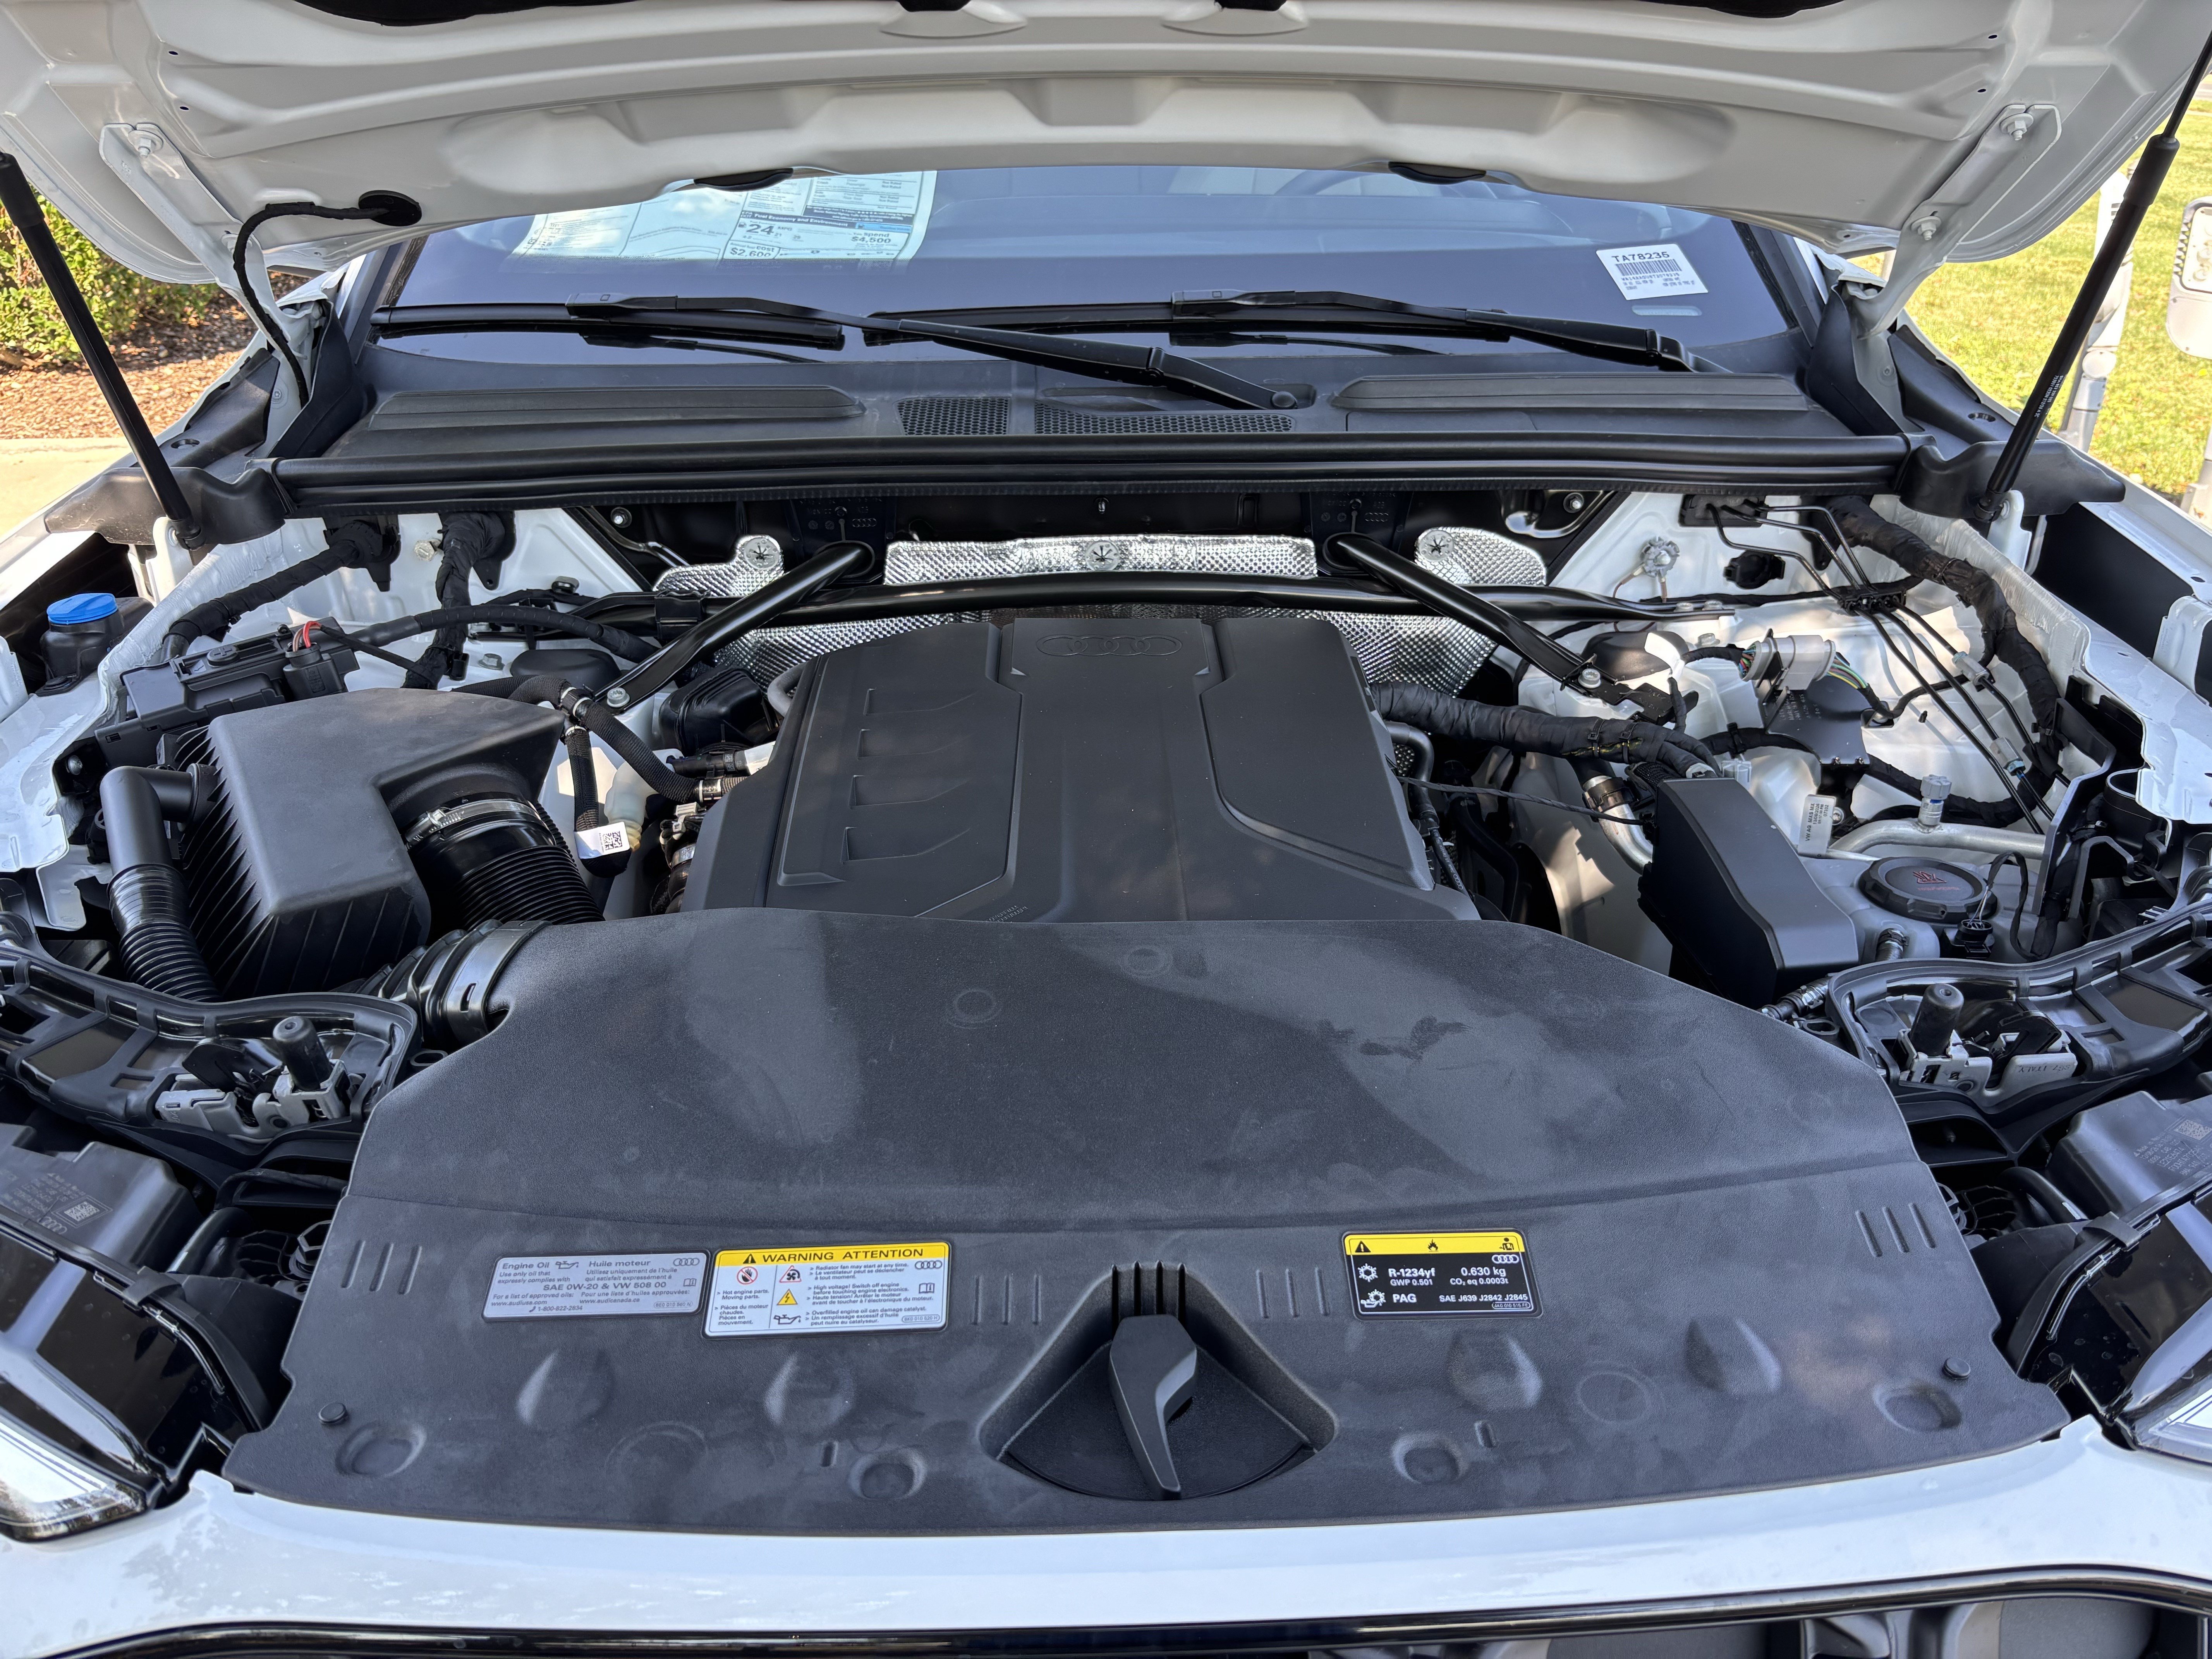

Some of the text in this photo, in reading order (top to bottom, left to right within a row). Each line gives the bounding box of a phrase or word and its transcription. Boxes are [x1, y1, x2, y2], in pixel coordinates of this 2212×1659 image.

[746, 224, 774, 235] 24
[730, 247, 771, 257] $2,600
[762, 1248, 923, 1262] WARNING ATTENTION
[1388, 1267, 1435, 1278] R-1234yf
[1461, 1266, 1506, 1277] 0.630 kg
[1393, 1293, 1417, 1302] PAG
